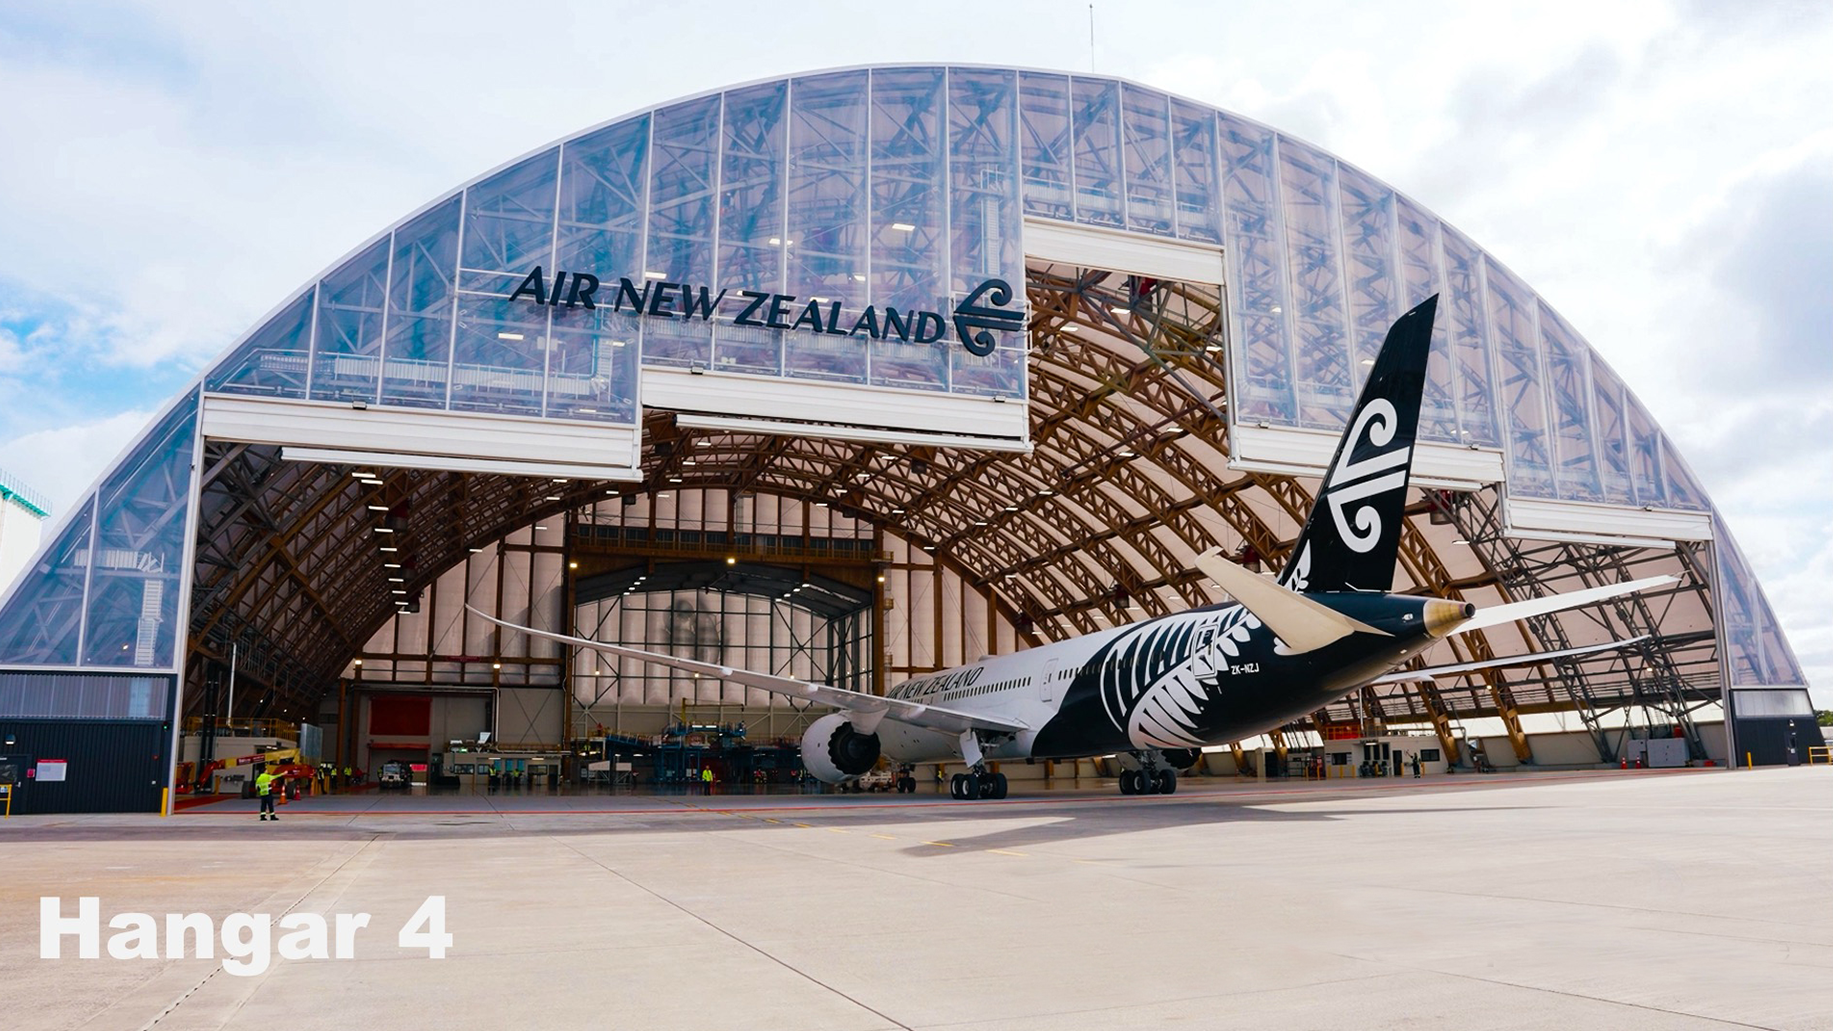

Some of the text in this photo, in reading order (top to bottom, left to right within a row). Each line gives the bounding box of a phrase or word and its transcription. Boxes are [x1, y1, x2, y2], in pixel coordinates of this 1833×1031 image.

[509, 266, 946, 344] AIR NEW ZEALAND
[900, 679, 929, 700] NEW
[923, 667, 984, 695] ZEALAND
[1231, 662, 1260, 675] ZK-NZJ
